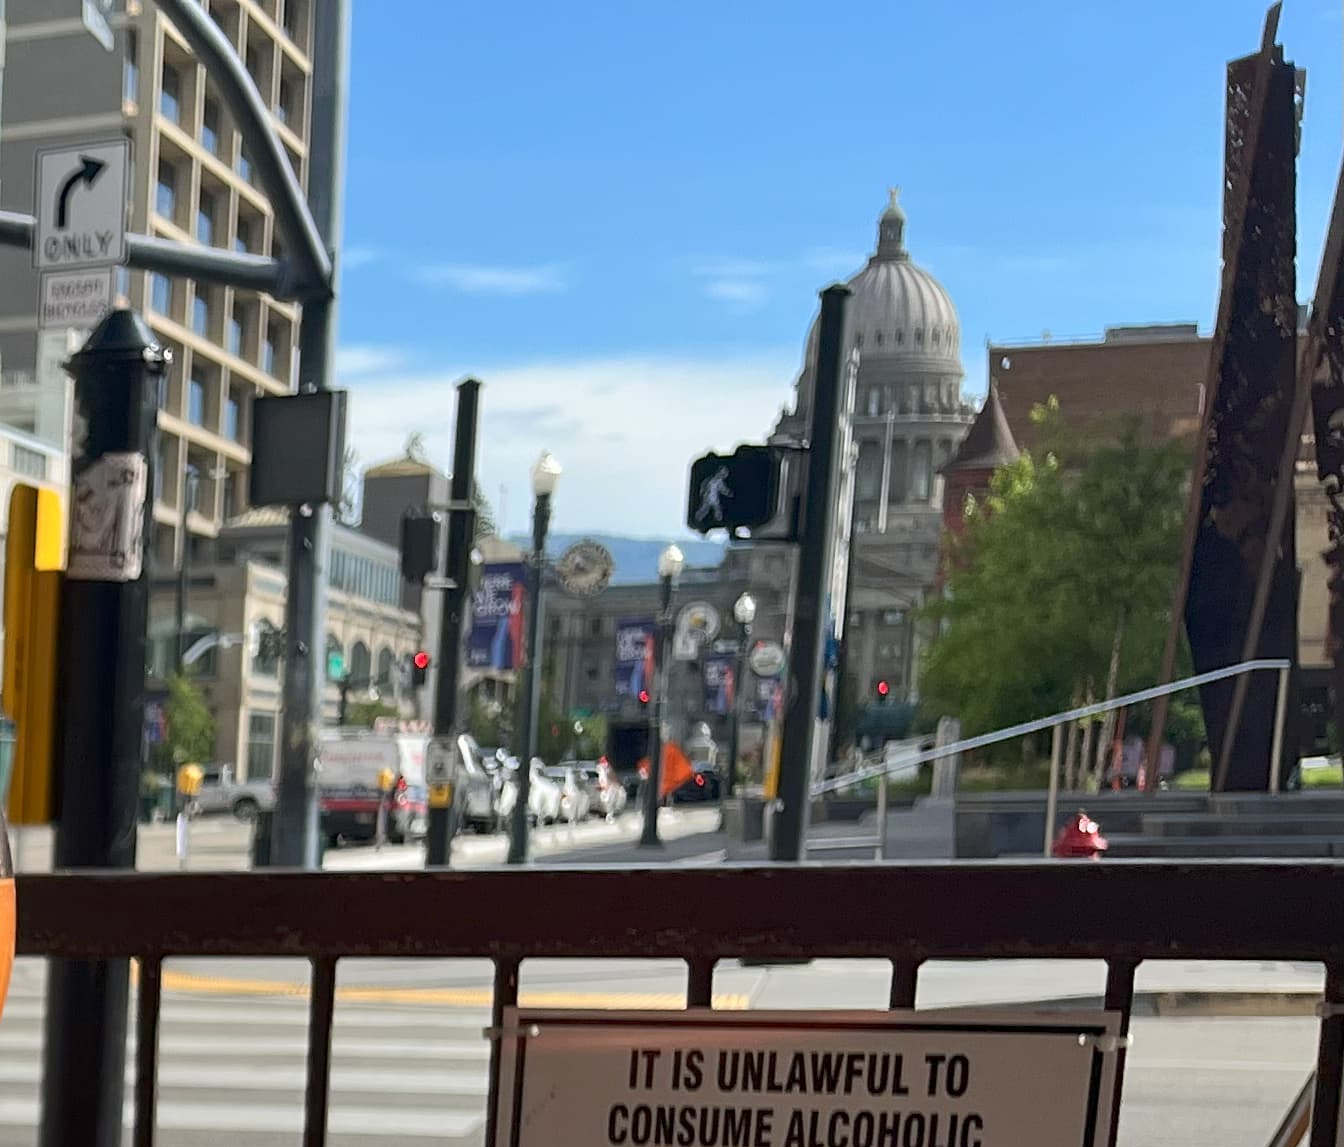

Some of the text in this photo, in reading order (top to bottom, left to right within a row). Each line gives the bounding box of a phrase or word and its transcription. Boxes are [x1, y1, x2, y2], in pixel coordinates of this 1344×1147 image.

[43, 229, 113, 262] ONLY
[629, 1049, 970, 1099] IT IS UNLAWFUL TO
